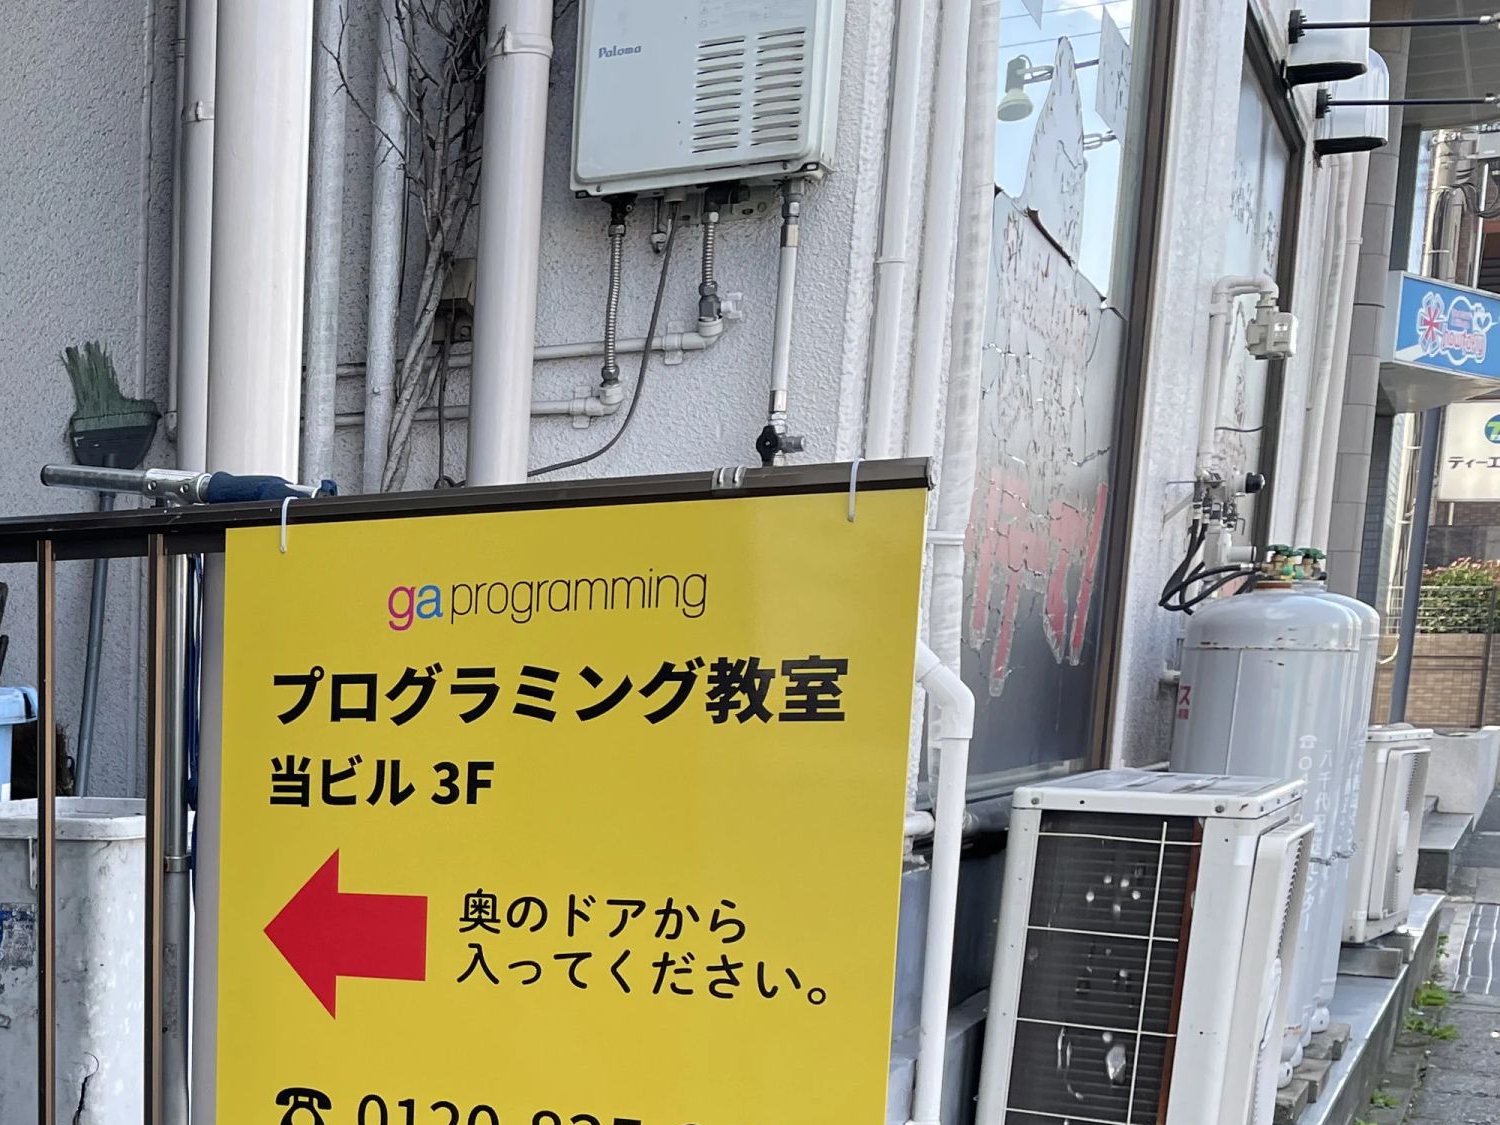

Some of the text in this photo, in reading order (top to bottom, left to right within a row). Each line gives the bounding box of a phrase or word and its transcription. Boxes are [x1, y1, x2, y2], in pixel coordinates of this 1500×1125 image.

[598, 44, 641, 59] Paloma
[388, 567, 707, 631] ga programming
[273, 655, 849, 726] プログラミング教室
[269, 753, 495, 808] 当ビル 3F
[458, 888, 746, 943] 奥のドアから
[456, 943, 827, 1005] 入ってください。
